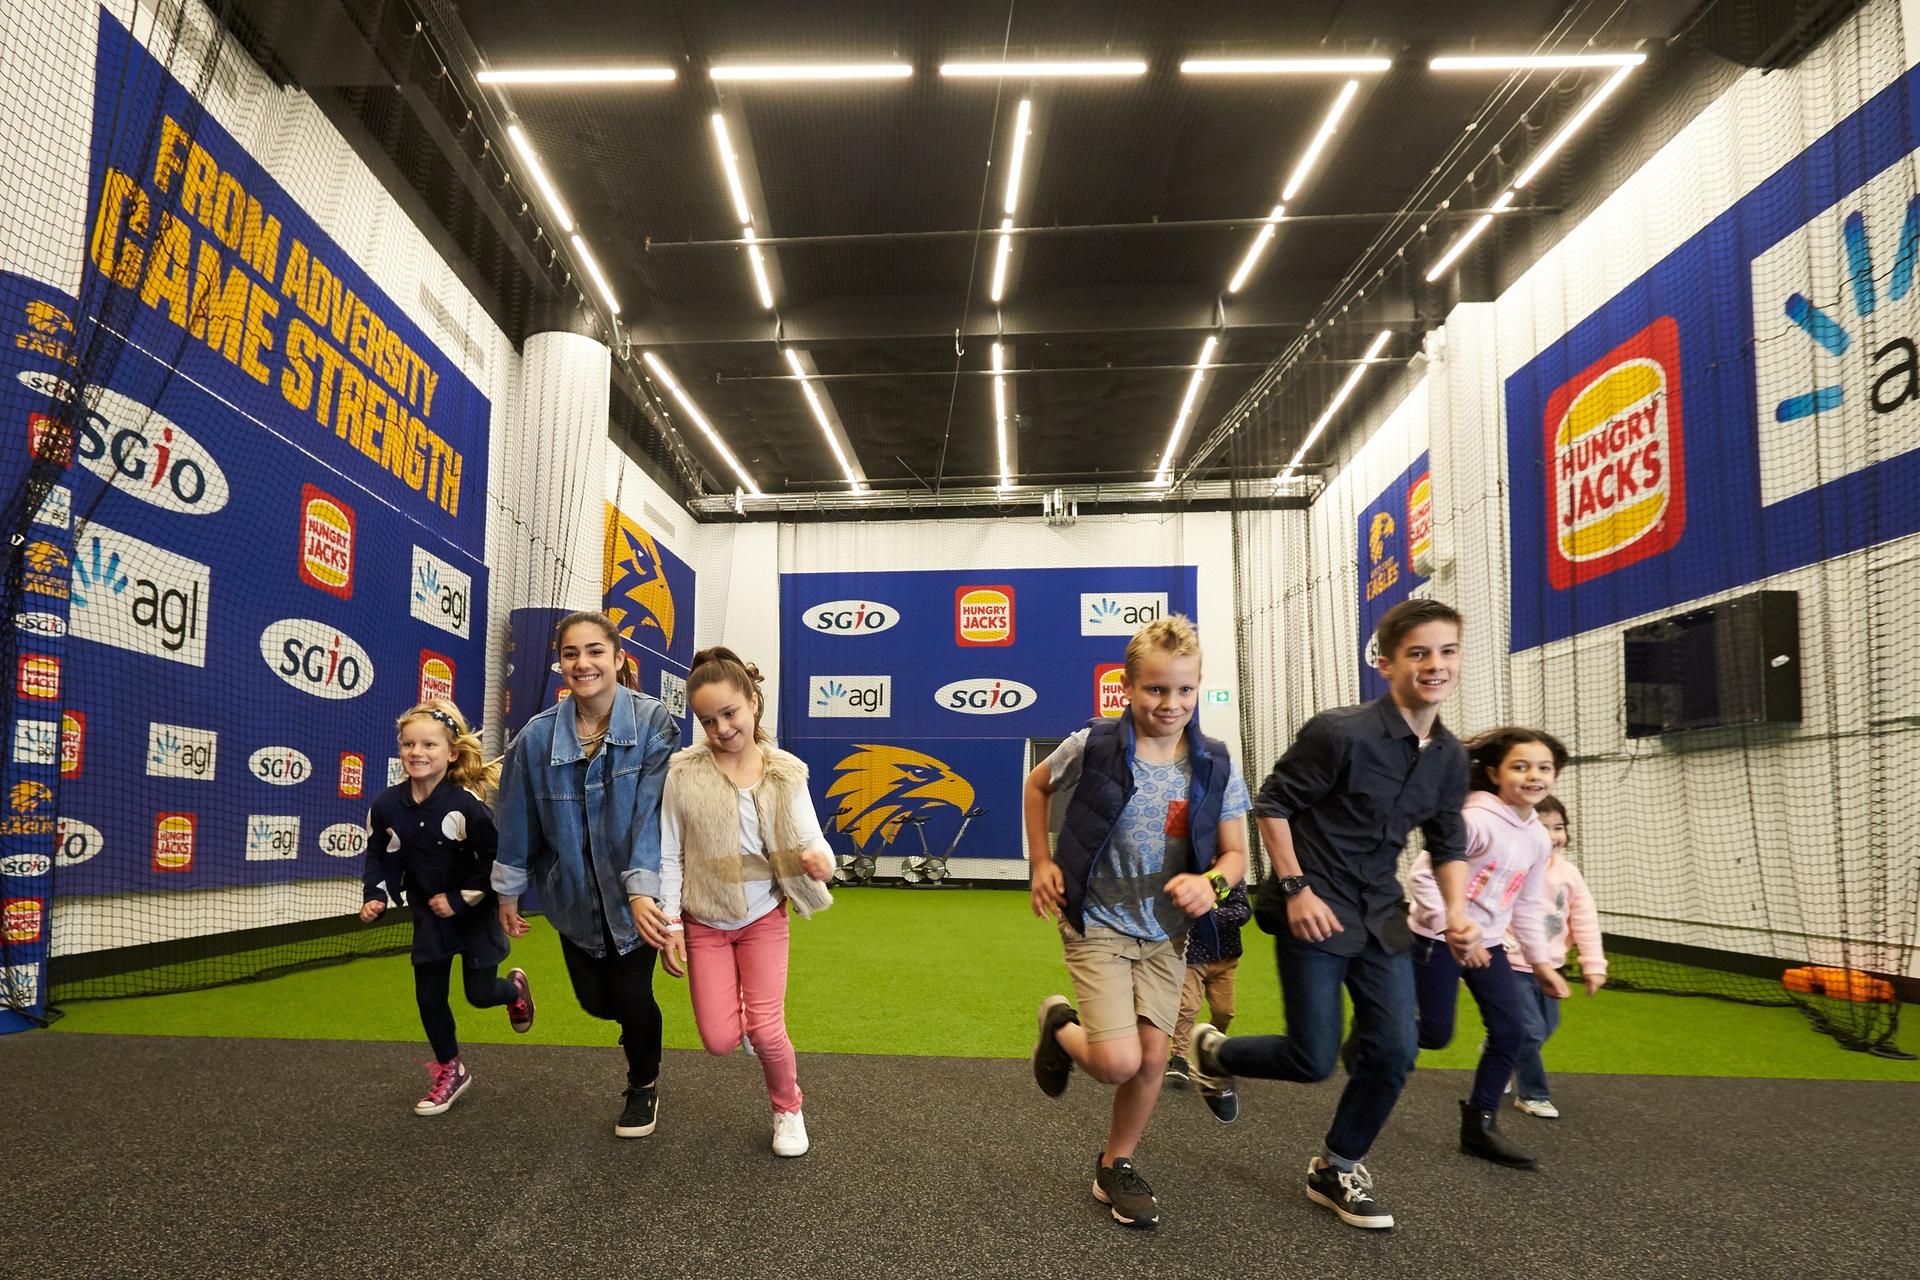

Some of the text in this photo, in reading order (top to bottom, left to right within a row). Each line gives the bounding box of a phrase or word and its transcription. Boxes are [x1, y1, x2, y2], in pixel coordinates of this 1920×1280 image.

[153, 113, 440, 418] FROM ADVERSITY
[90, 166, 463, 518] GAME STRENGTH
[1561, 399, 1658, 480] HUNGRY
[79, 410, 207, 504] SGiO
[309, 519, 348, 549] HUNGRY
[132, 579, 199, 650] agl
[441, 585, 467, 629] agl
[817, 603, 885, 630] SGiO
[963, 606, 1006, 615] HUNGRY
[279, 634, 360, 691] SGiO
[848, 682, 883, 713] agl
[950, 682, 1021, 709] SGiO
[1103, 685, 1126, 693] HUN
[1103, 695, 1127, 708] JAC
[181, 740, 211, 775] agl
[258, 752, 304, 780] SGiO
[272, 830, 295, 855] agl
[326, 826, 363, 852] SGiO
